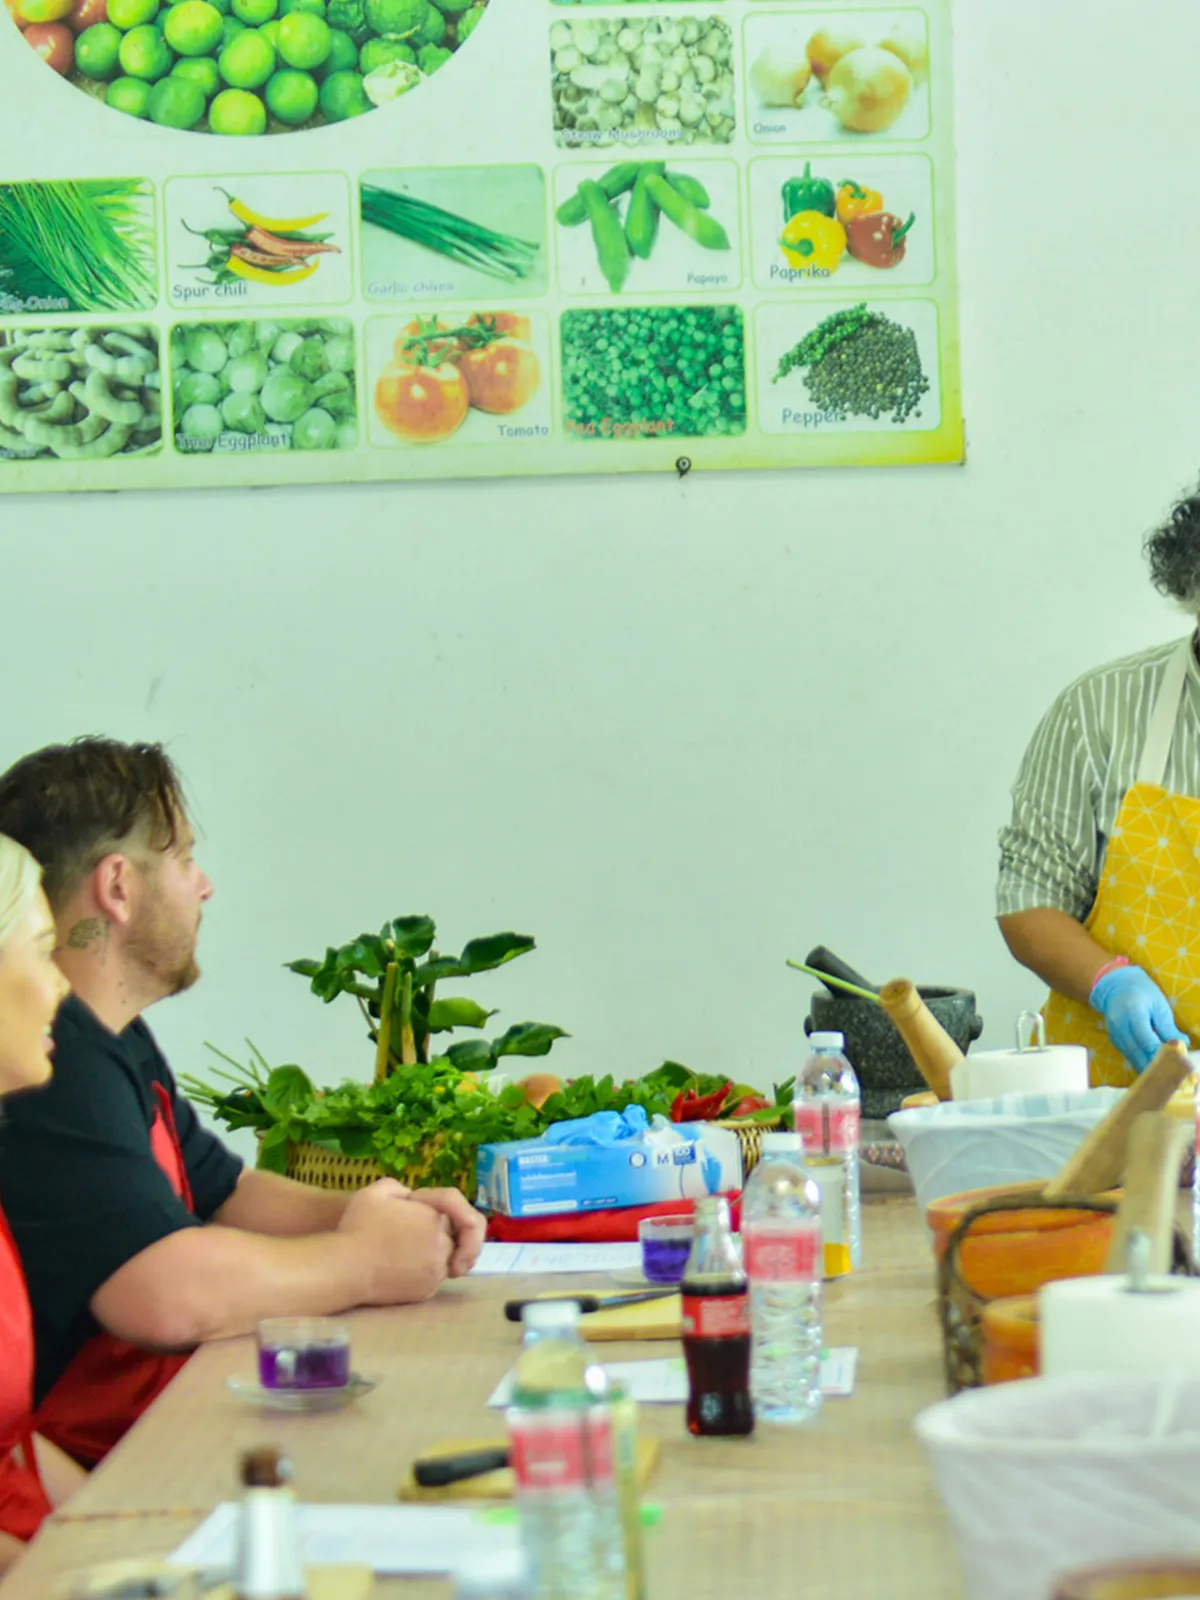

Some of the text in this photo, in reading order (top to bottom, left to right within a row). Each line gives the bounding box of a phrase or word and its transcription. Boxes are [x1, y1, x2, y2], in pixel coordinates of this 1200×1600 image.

[753, 122, 787, 134] Onion
[769, 263, 831, 282] Paprika
[173, 281, 247, 301] Spur chili
[368, 281, 408, 296] Garlic
[782, 407, 839, 428] Pepper
[498, 424, 549, 436] Tomato
[217, 431, 288, 452] Eggplant
[657, 1153, 669, 1165] M
